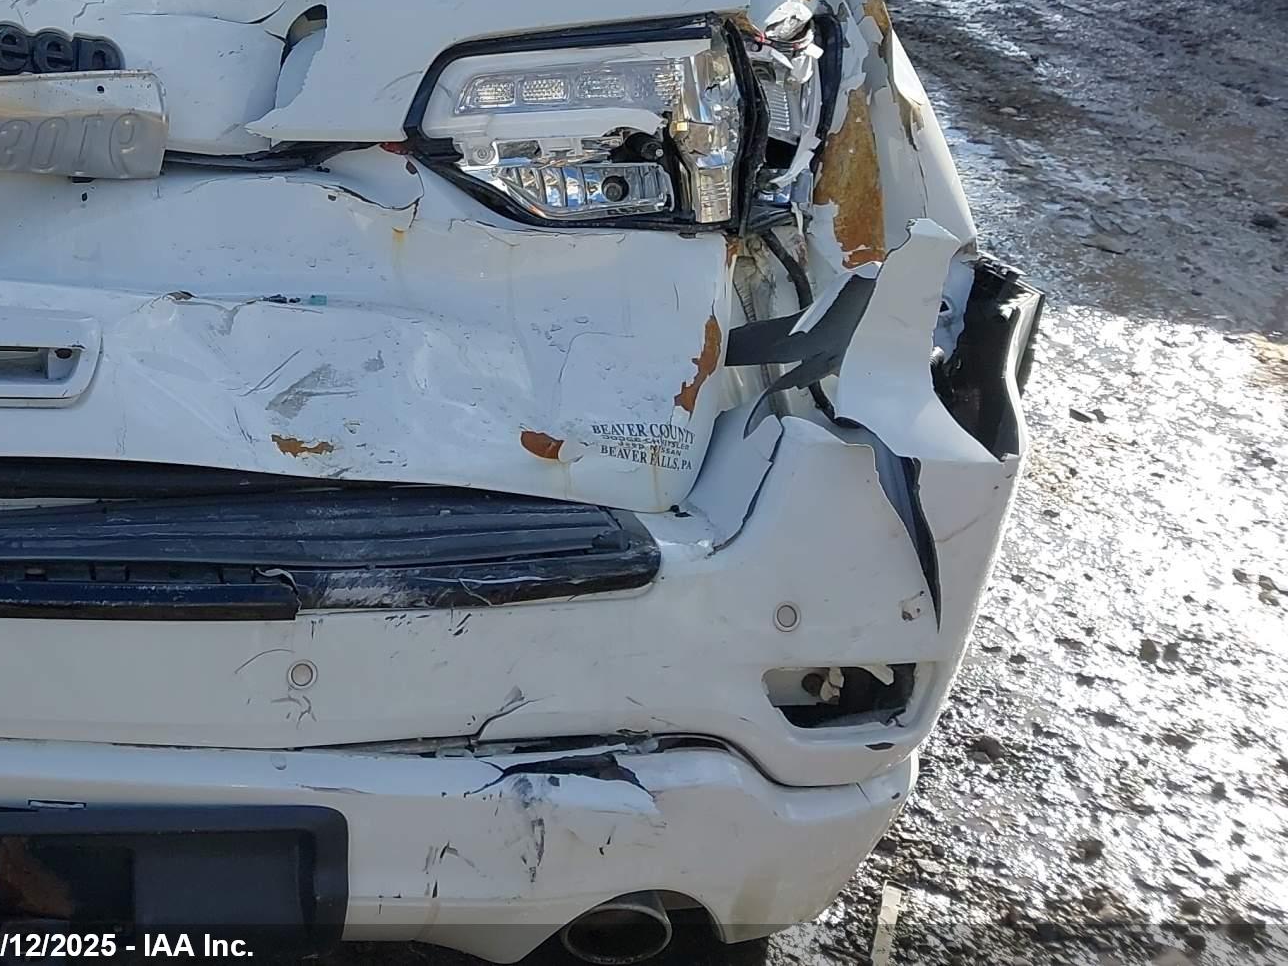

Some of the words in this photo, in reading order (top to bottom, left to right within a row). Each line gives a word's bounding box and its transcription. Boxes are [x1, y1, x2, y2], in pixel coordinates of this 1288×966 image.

[592, 424, 648, 437] BEAVER
[650, 423, 695, 444] COUNTY
[600, 444, 647, 464] BEAVER
[681, 459, 692, 470] PA
